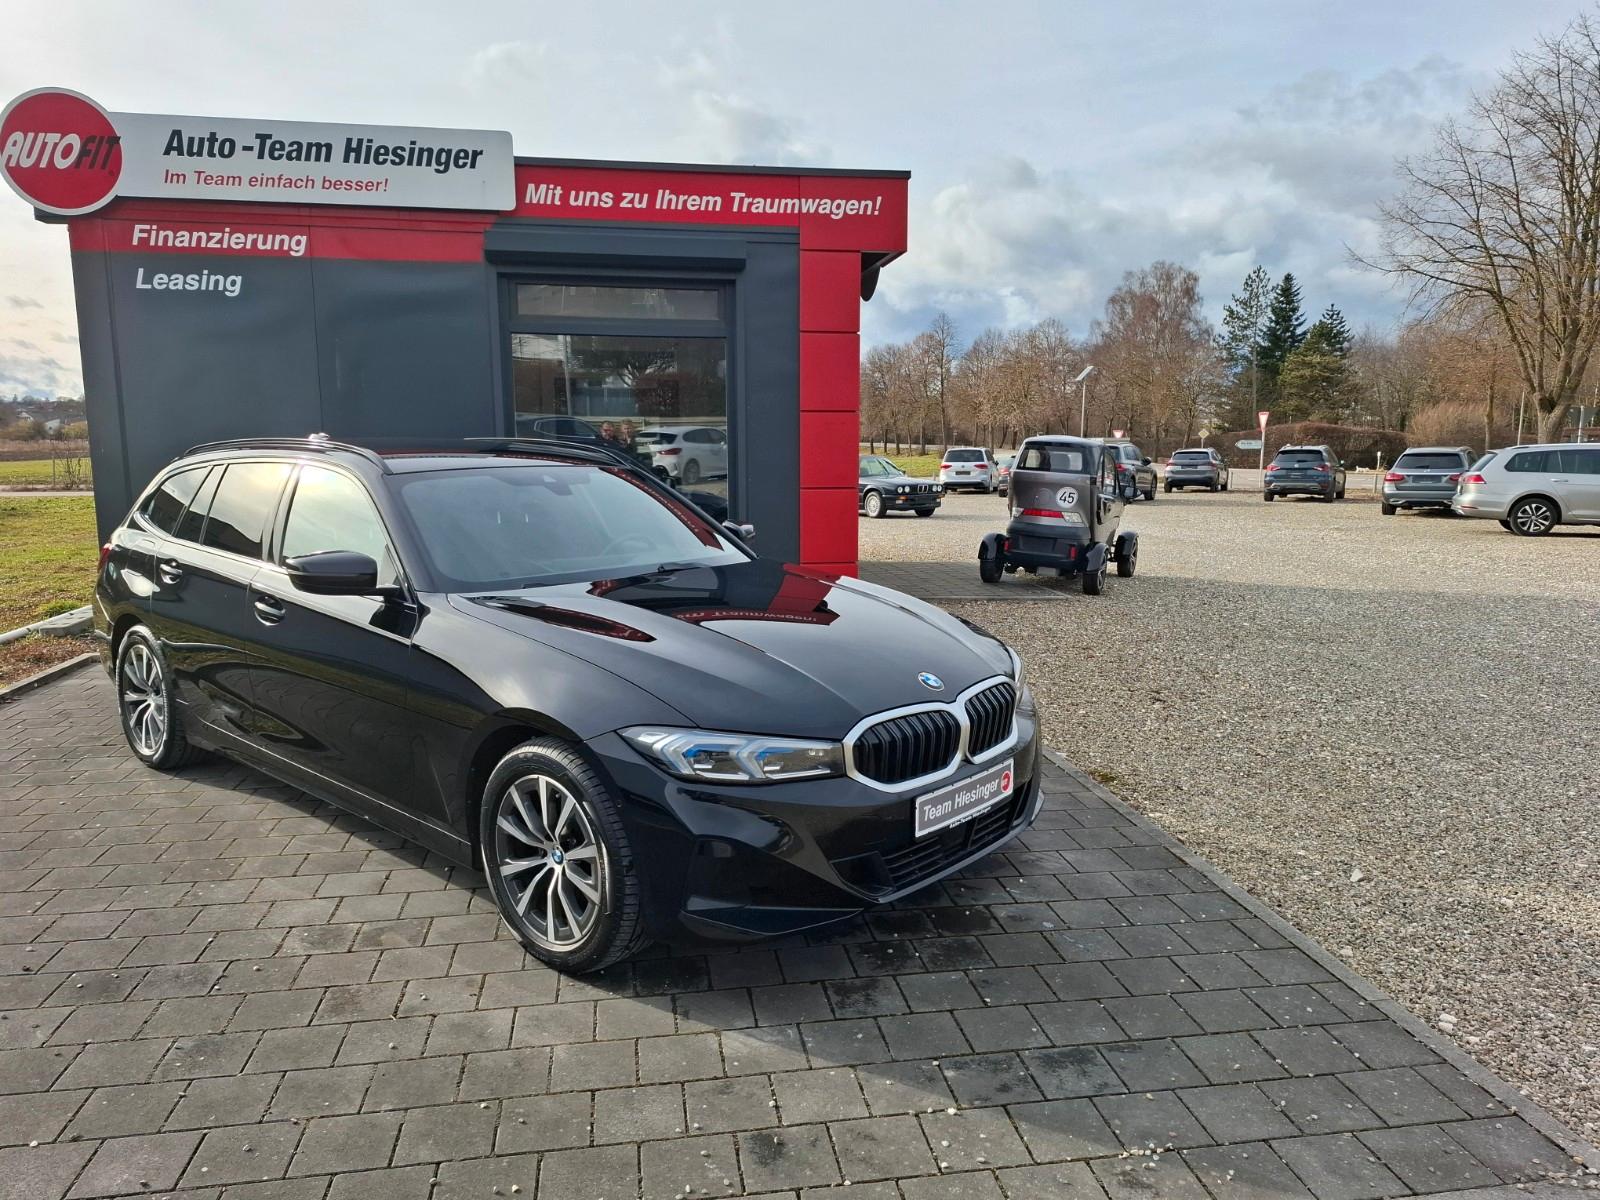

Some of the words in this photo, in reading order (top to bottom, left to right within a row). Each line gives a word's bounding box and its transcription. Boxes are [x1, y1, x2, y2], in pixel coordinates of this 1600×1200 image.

[1, 131, 121, 170] AUTOFIT
[343, 137, 484, 174] Hiesinger
[164, 169, 187, 184] Im
[194, 170, 242, 186] Team
[248, 173, 315, 189] einfach
[321, 176, 389, 192] besser!
[525, 183, 563, 205] Mit
[569, 190, 614, 208] uns
[619, 192, 648, 209] zu
[655, 189, 722, 211] Ihrem
[730, 192, 882, 220] Traumwagen!
[132, 224, 307, 257] Finanzierung
[135, 267, 242, 297] Leasing
[1059, 491, 1076, 504] 45
[923, 800, 952, 822] Team
[954, 779, 999, 809] Hiesinger
